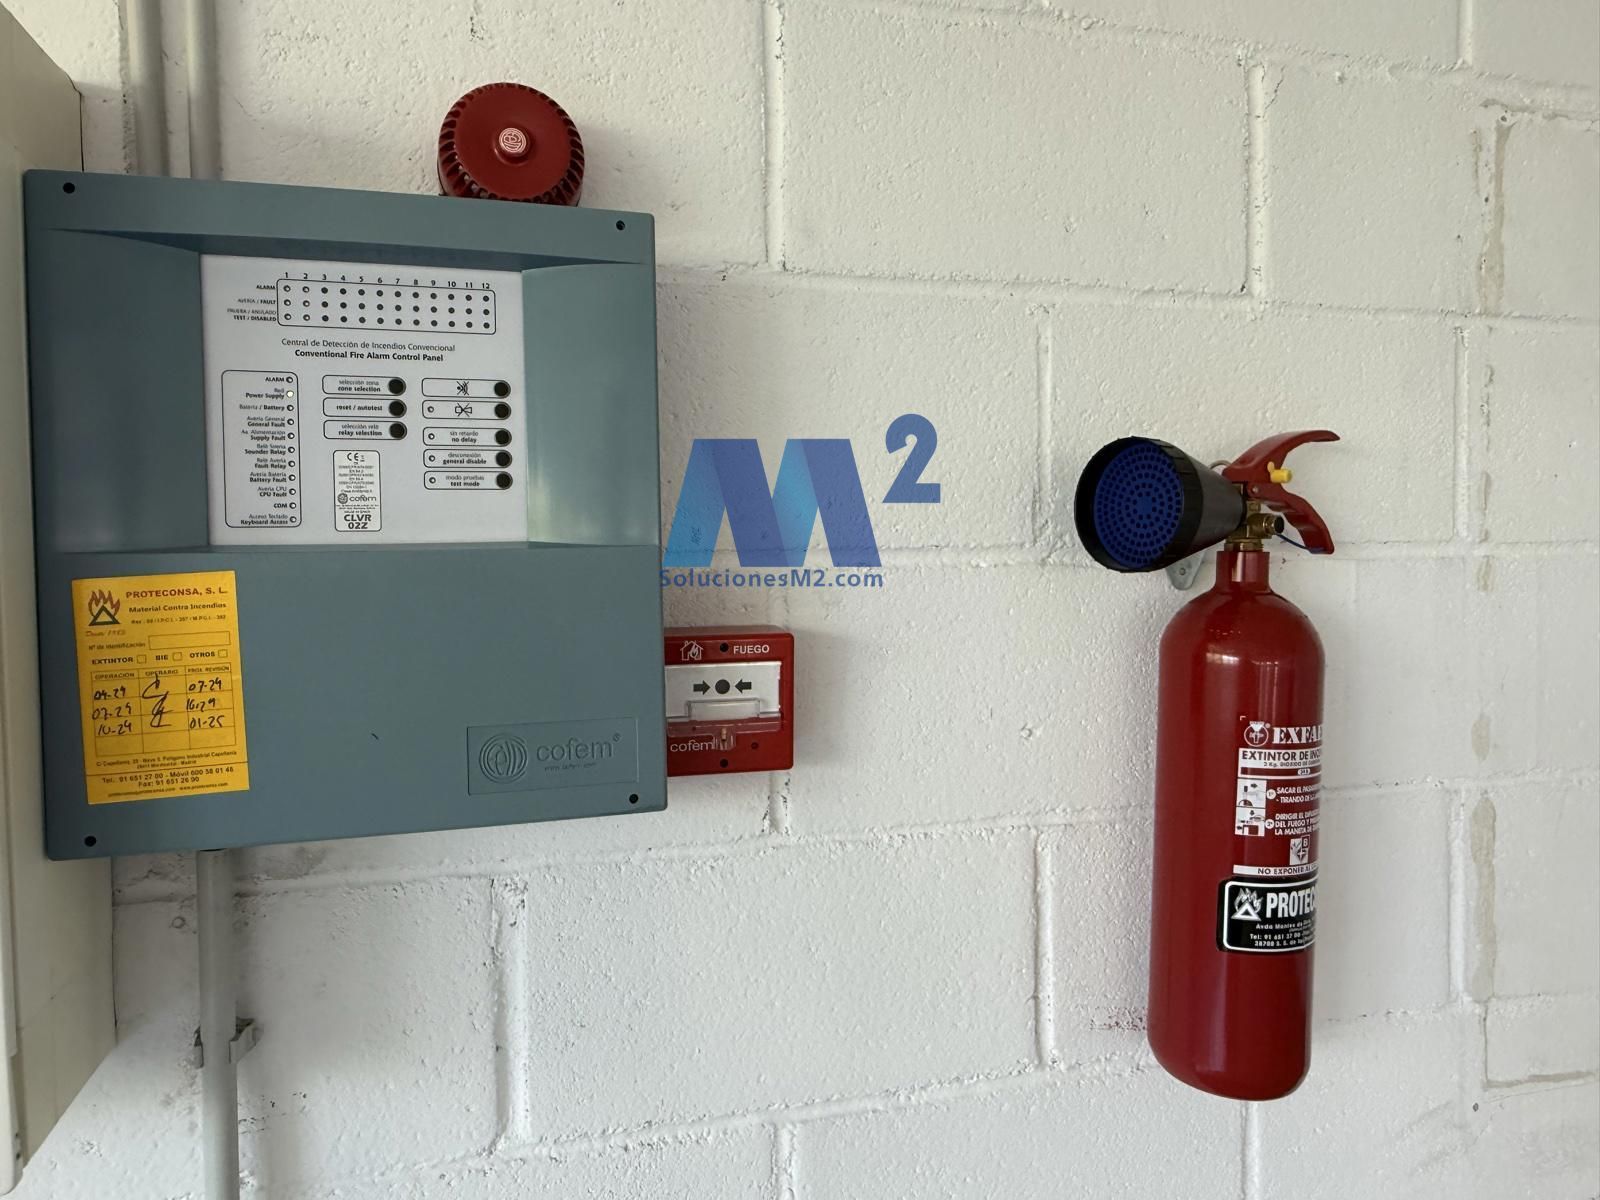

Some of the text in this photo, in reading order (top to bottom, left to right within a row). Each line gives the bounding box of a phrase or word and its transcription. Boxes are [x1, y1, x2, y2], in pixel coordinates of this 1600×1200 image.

[281, 338, 309, 346] Central
[310, 339, 320, 347] de
[322, 340, 358, 348] Detección
[360, 341, 370, 349] de
[372, 342, 406, 350] Incendios
[295, 349, 347, 358] Conventional
[350, 351, 364, 359] Fire
[367, 352, 390, 360] Alarm
[344, 514, 372, 522] CLVR
[126, 586, 228, 599] PROTECONSA, S. L.
[129, 605, 161, 613] Material
[190, 602, 227, 610] Incendios
[733, 644, 770, 654] FUEGO
[92, 657, 134, 665] EXTINTOR
[145, 669, 179, 677] OPERARIO
[536, 737, 614, 762] cofem
[670, 739, 714, 752] cofem
[1242, 750, 1308, 761] EXTINTOR DE
[1275, 812, 1298, 820] DIRIGIR
[1287, 820, 1306, 828] FUEGO
[1273, 866, 1304, 875] EXPONER
